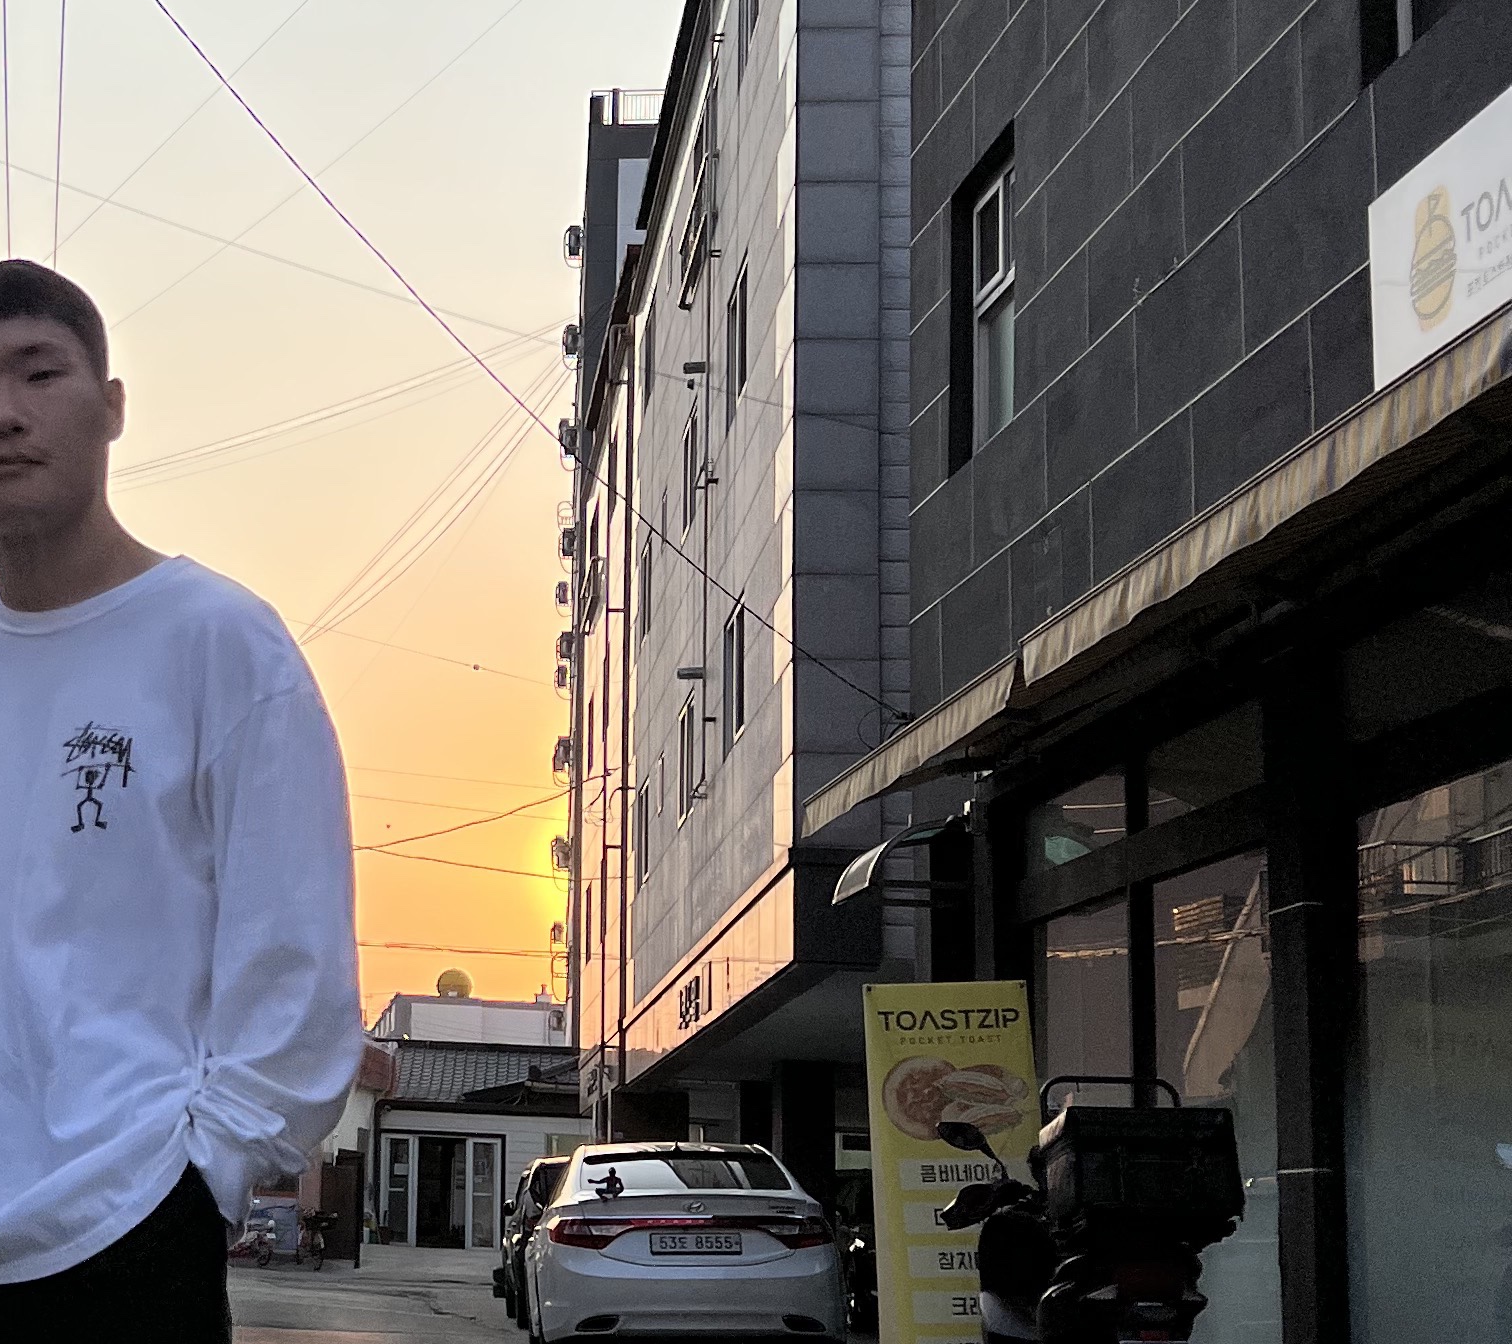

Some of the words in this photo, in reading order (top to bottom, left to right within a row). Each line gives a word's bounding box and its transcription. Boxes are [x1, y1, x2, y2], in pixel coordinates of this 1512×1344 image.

[876, 1008, 1020, 1032] TOASTZIP
[899, 1036, 953, 1045] POCKET
[959, 1034, 1003, 1044] TOAST
[694, 1235, 734, 1249] 8555
